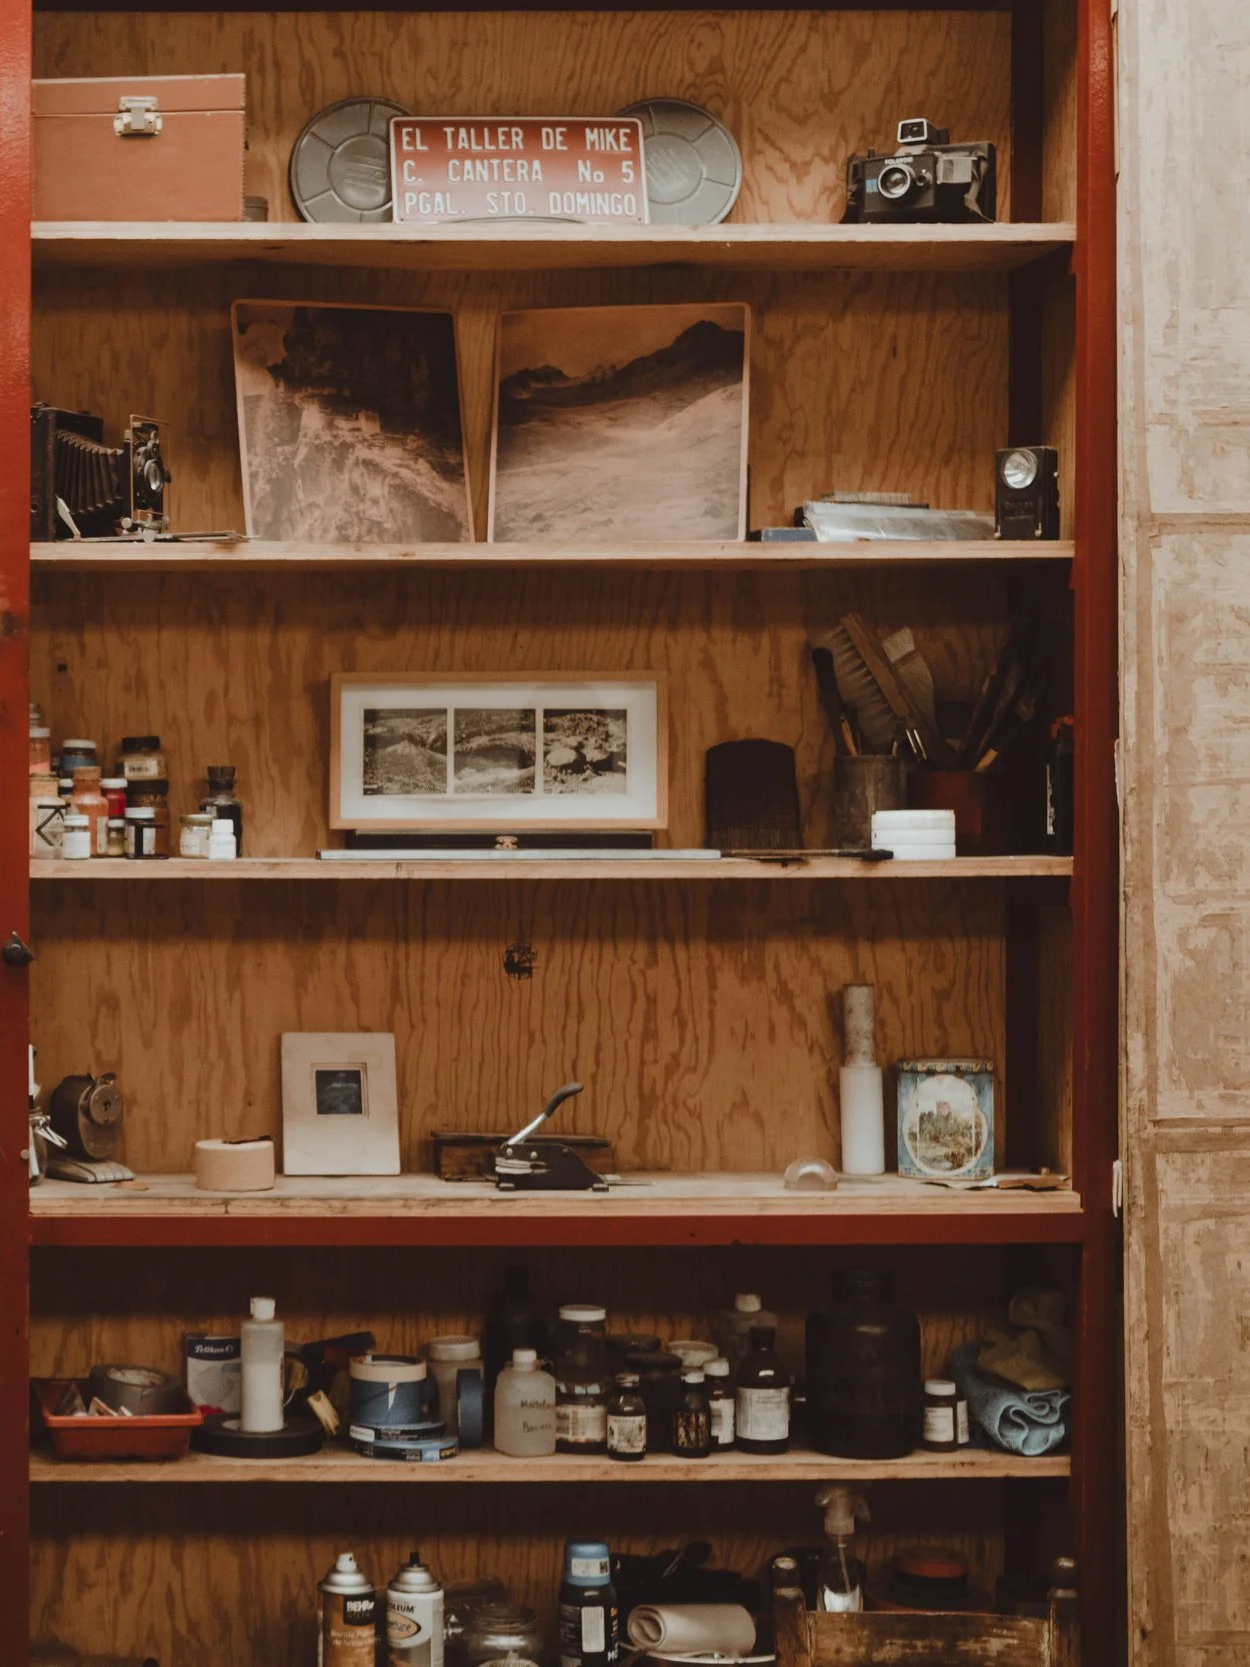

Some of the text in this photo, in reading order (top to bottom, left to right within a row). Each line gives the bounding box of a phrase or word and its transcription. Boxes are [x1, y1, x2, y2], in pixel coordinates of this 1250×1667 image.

[401, 127, 632, 152] EL TALLER DE MIKE
[402, 159, 423, 184] C.
[448, 159, 543, 183] CANTERA
[621, 159, 635, 184] 5
[404, 191, 637, 216] PGAL. STO. DOMINGO
[193, 1343, 225, 1354] Pelikan
